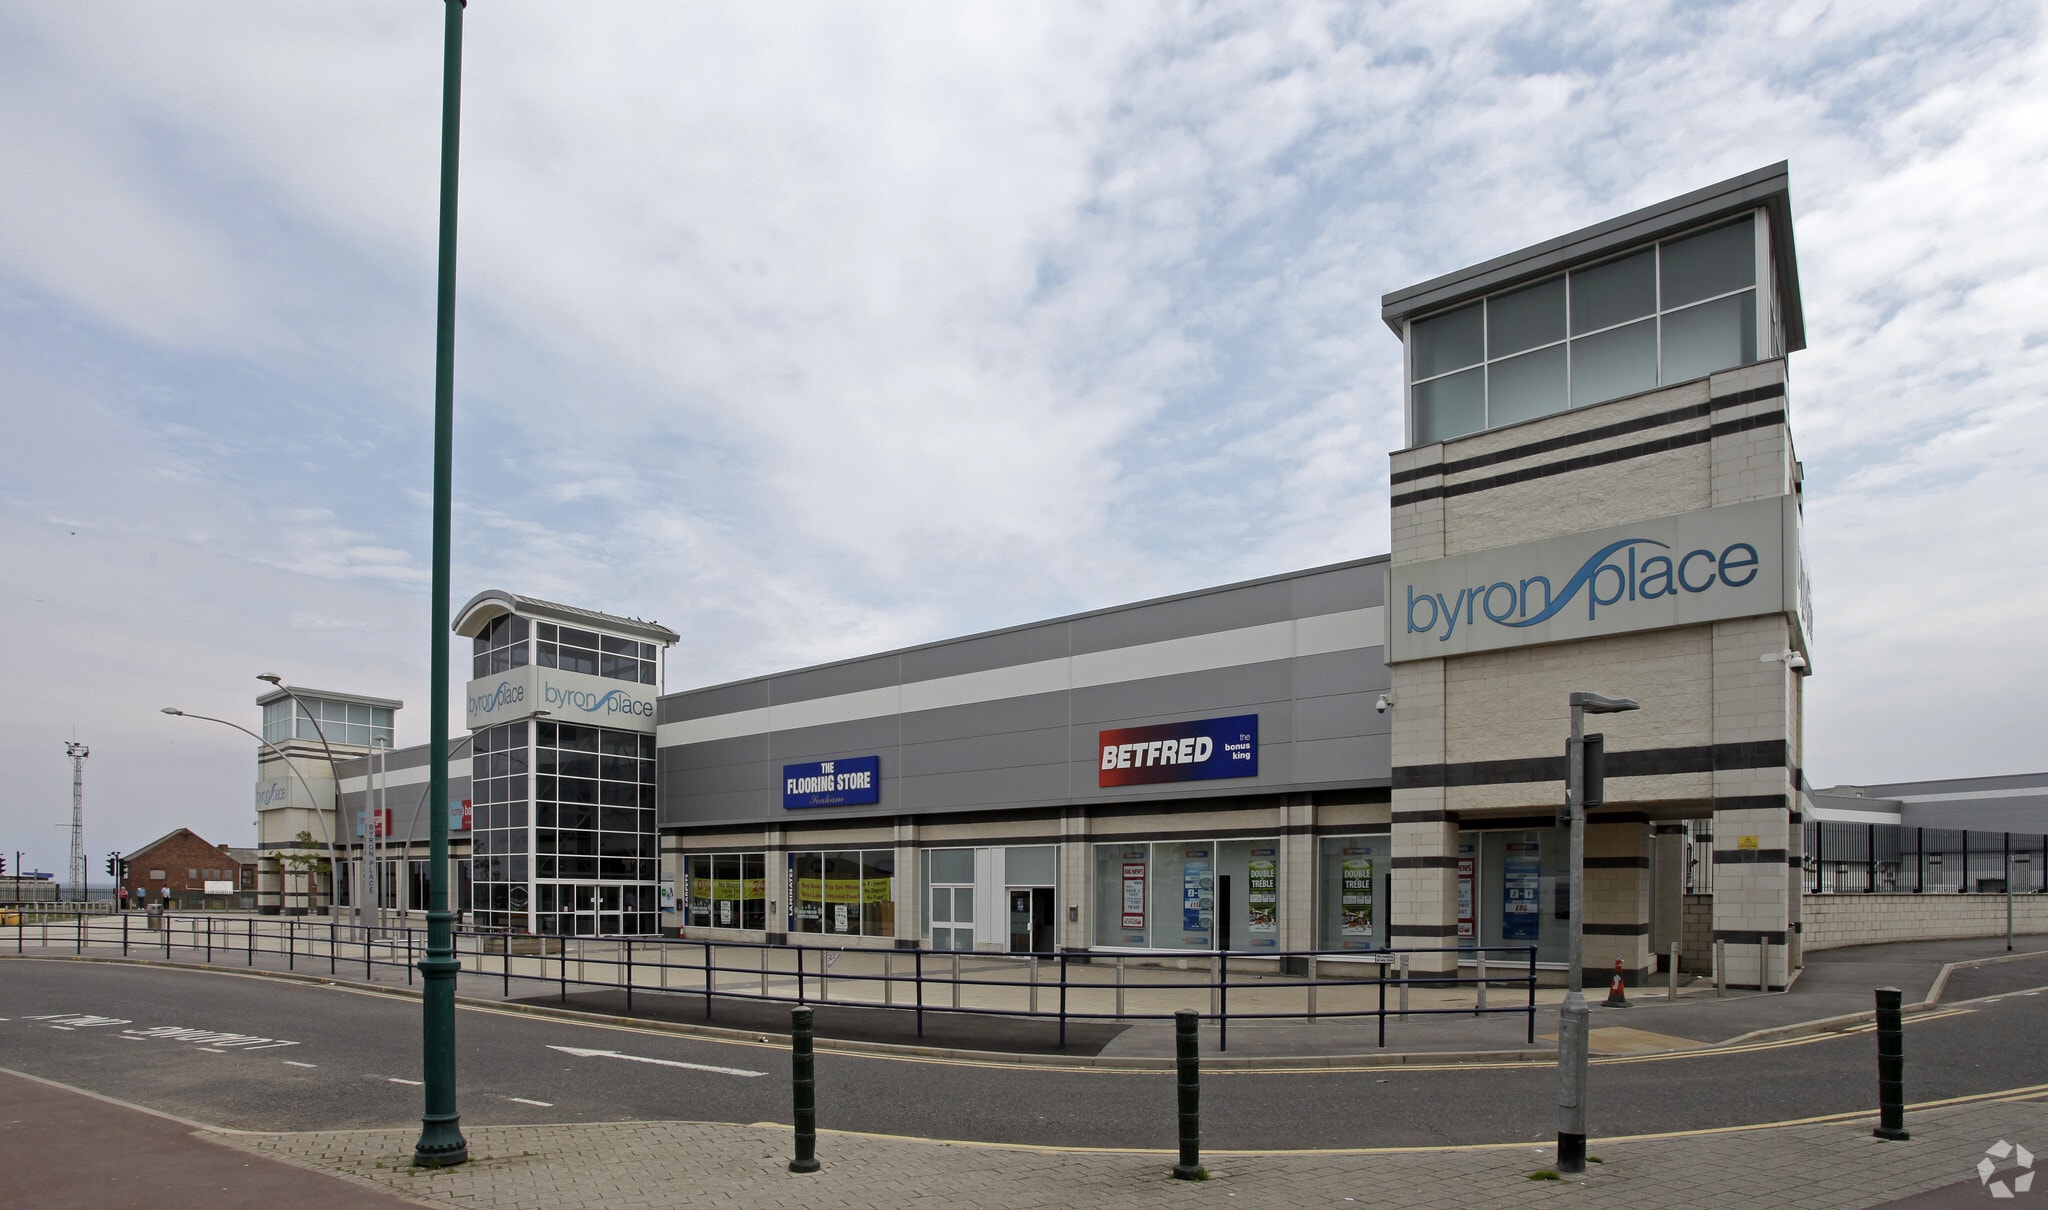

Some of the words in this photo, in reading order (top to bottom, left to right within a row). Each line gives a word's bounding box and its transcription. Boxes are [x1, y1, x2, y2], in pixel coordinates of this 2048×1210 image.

[1407, 575, 1551, 642] byron
[1588, 542, 1759, 621] place
[468, 692, 493, 717] byron
[497, 685, 524, 711] place
[545, 681, 597, 710] byron
[607, 693, 653, 718] place
[1239, 733, 1251, 742] the
[1224, 742, 1251, 751] bonus
[1101, 736, 1213, 770] BETFRED
[1232, 751, 1251, 760] king
[820, 762, 835, 774] THE
[787, 775, 835, 795] FLOORING
[836, 771, 871, 791] STORE
[1250, 869, 1275, 878] DOUBLE
[1344, 869, 1371, 878] DOUBLE
[1251, 879, 1274, 888] TREBLE
[1345, 880, 1370, 889] TREBLE
